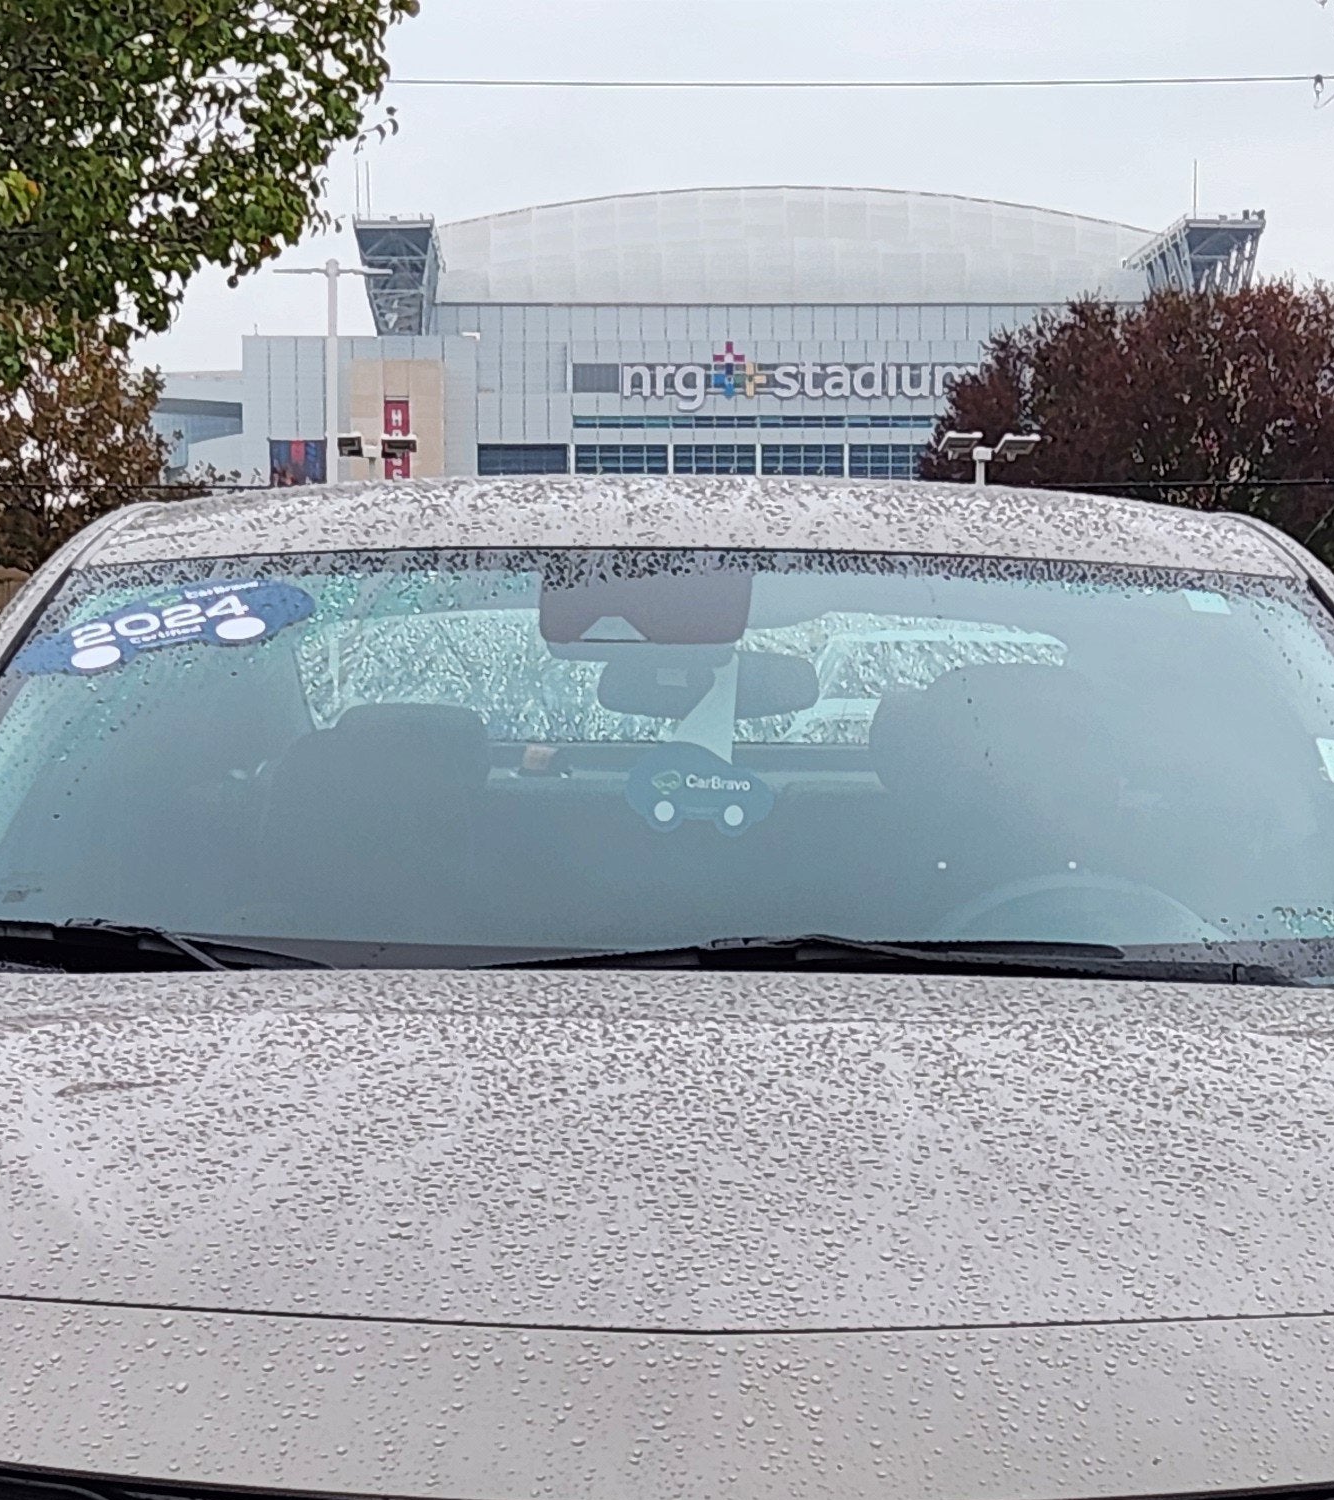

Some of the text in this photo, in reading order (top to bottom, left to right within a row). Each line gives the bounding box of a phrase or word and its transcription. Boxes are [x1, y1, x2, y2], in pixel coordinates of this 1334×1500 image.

[622, 363, 706, 413] nrg
[71, 595, 249, 649] 2024
[685, 773, 751, 792] CarBravo
